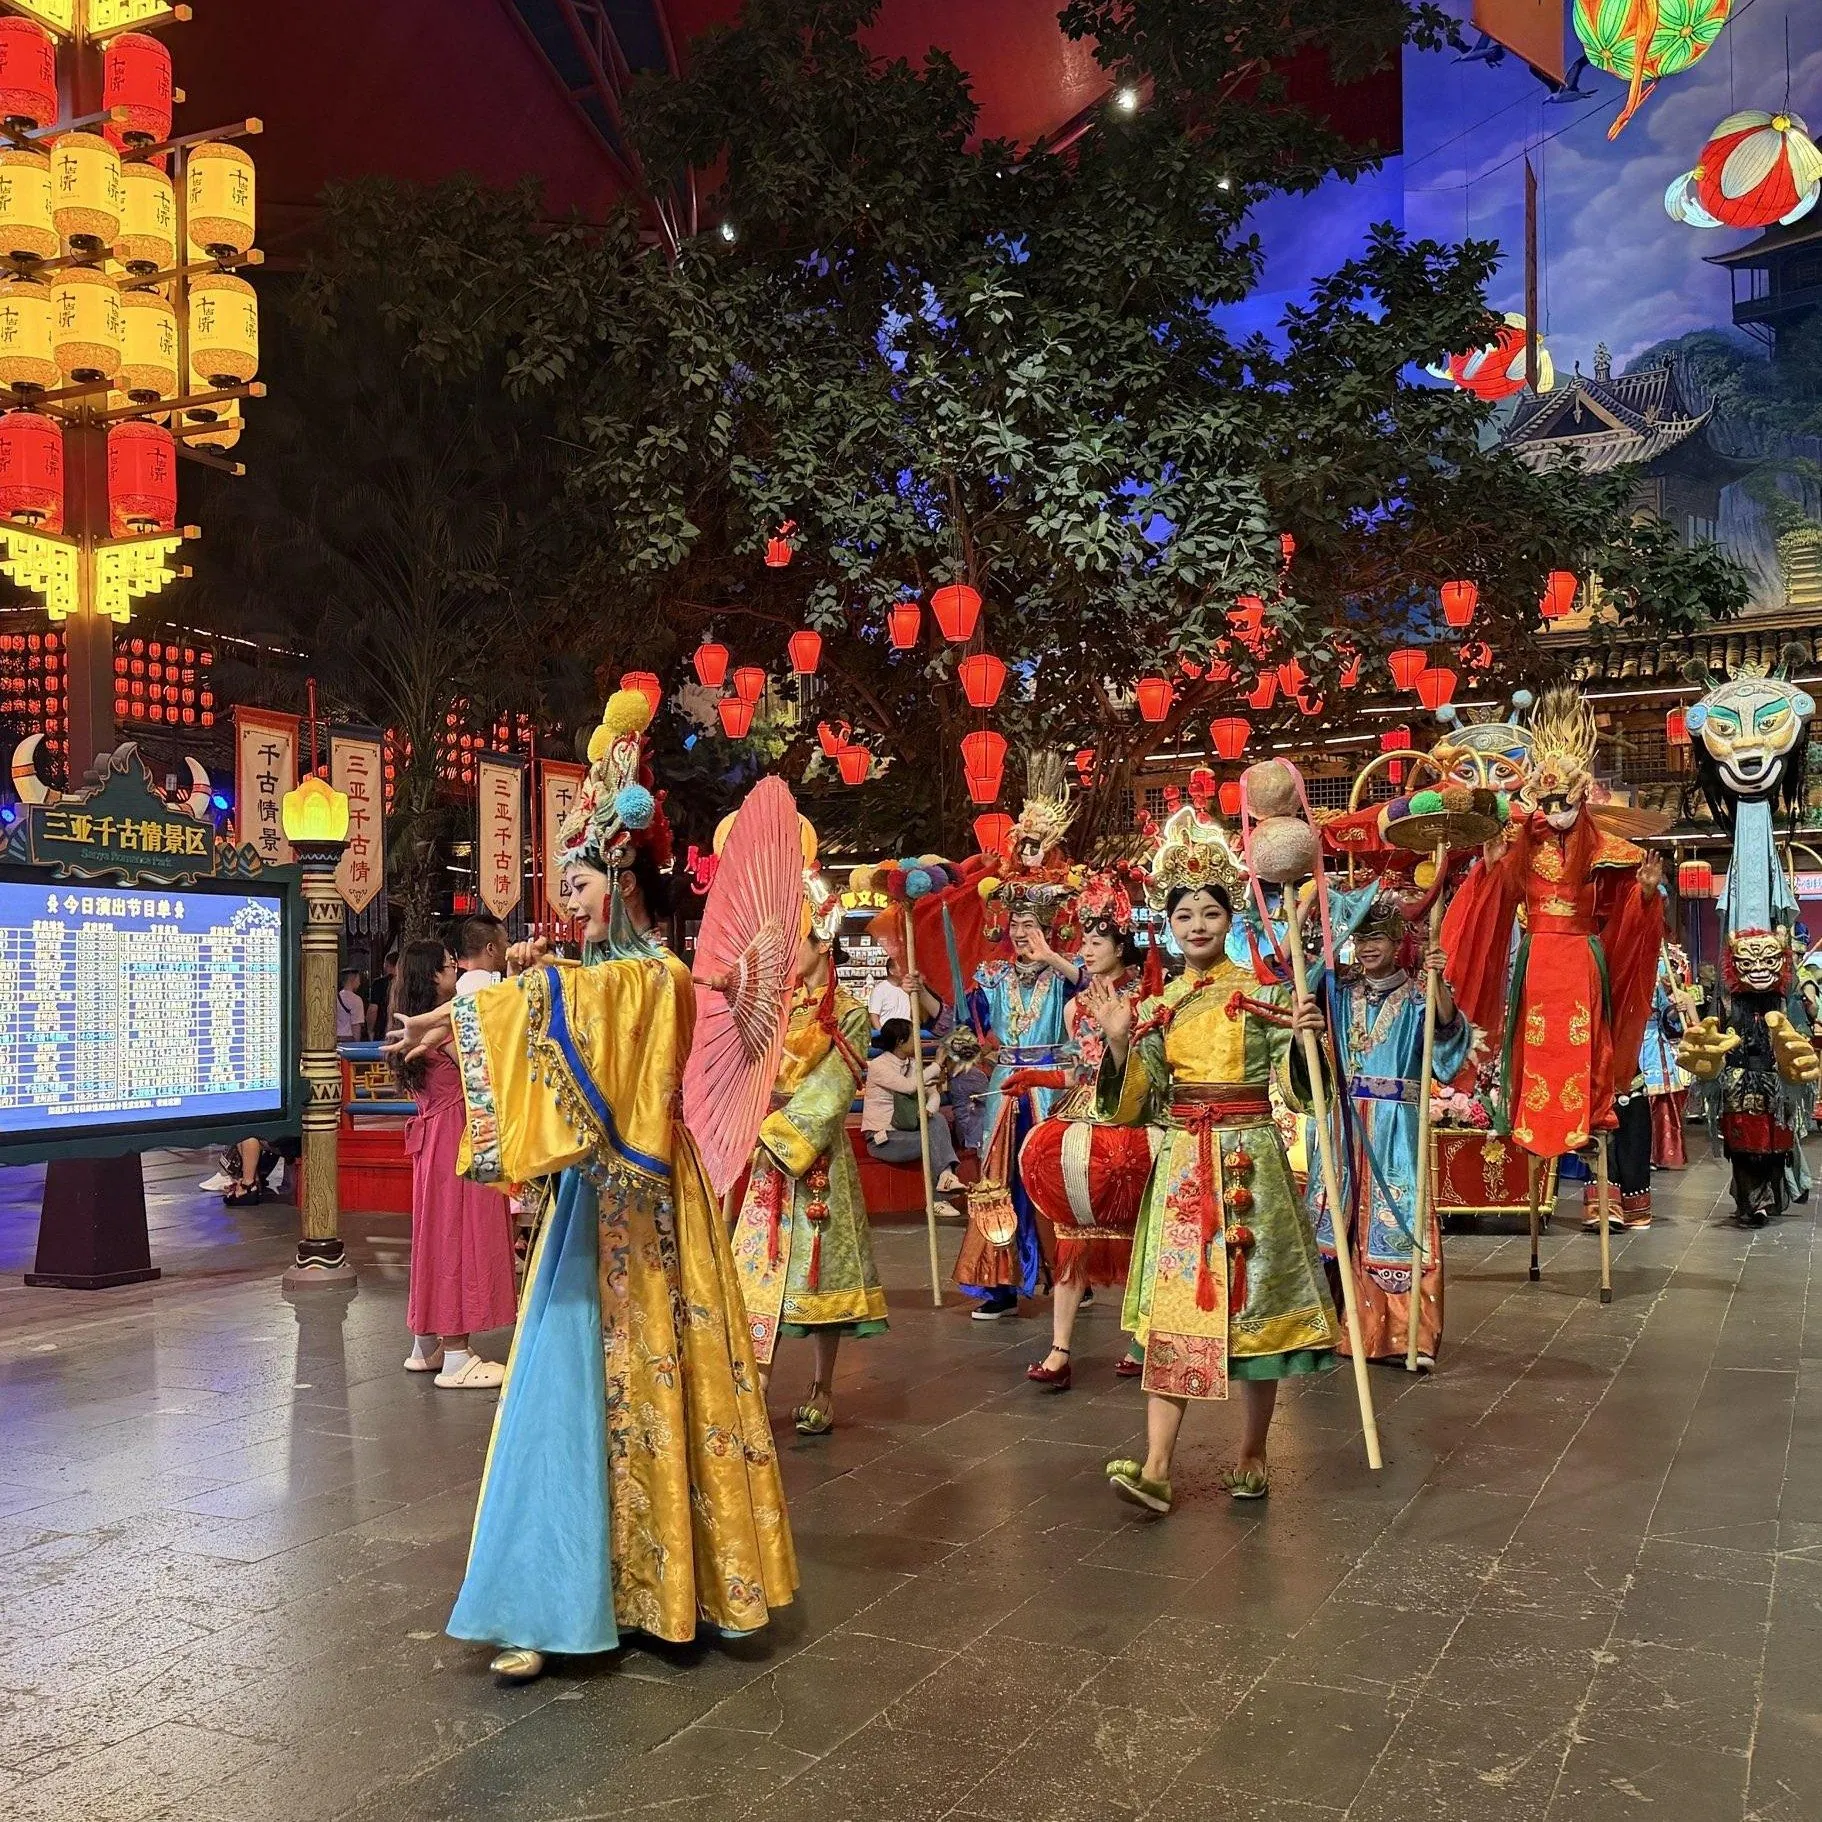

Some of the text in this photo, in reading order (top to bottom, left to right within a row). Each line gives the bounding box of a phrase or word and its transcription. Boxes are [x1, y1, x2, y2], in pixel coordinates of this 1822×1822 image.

[43, 811, 208, 856] 三亚千古情景区
[256, 743, 281, 863] 千古情景
[346, 755, 371, 883] 三亚千古情
[493, 779, 513, 895] 三亚千古情
[63, 894, 171, 918] 今日演出节目单
